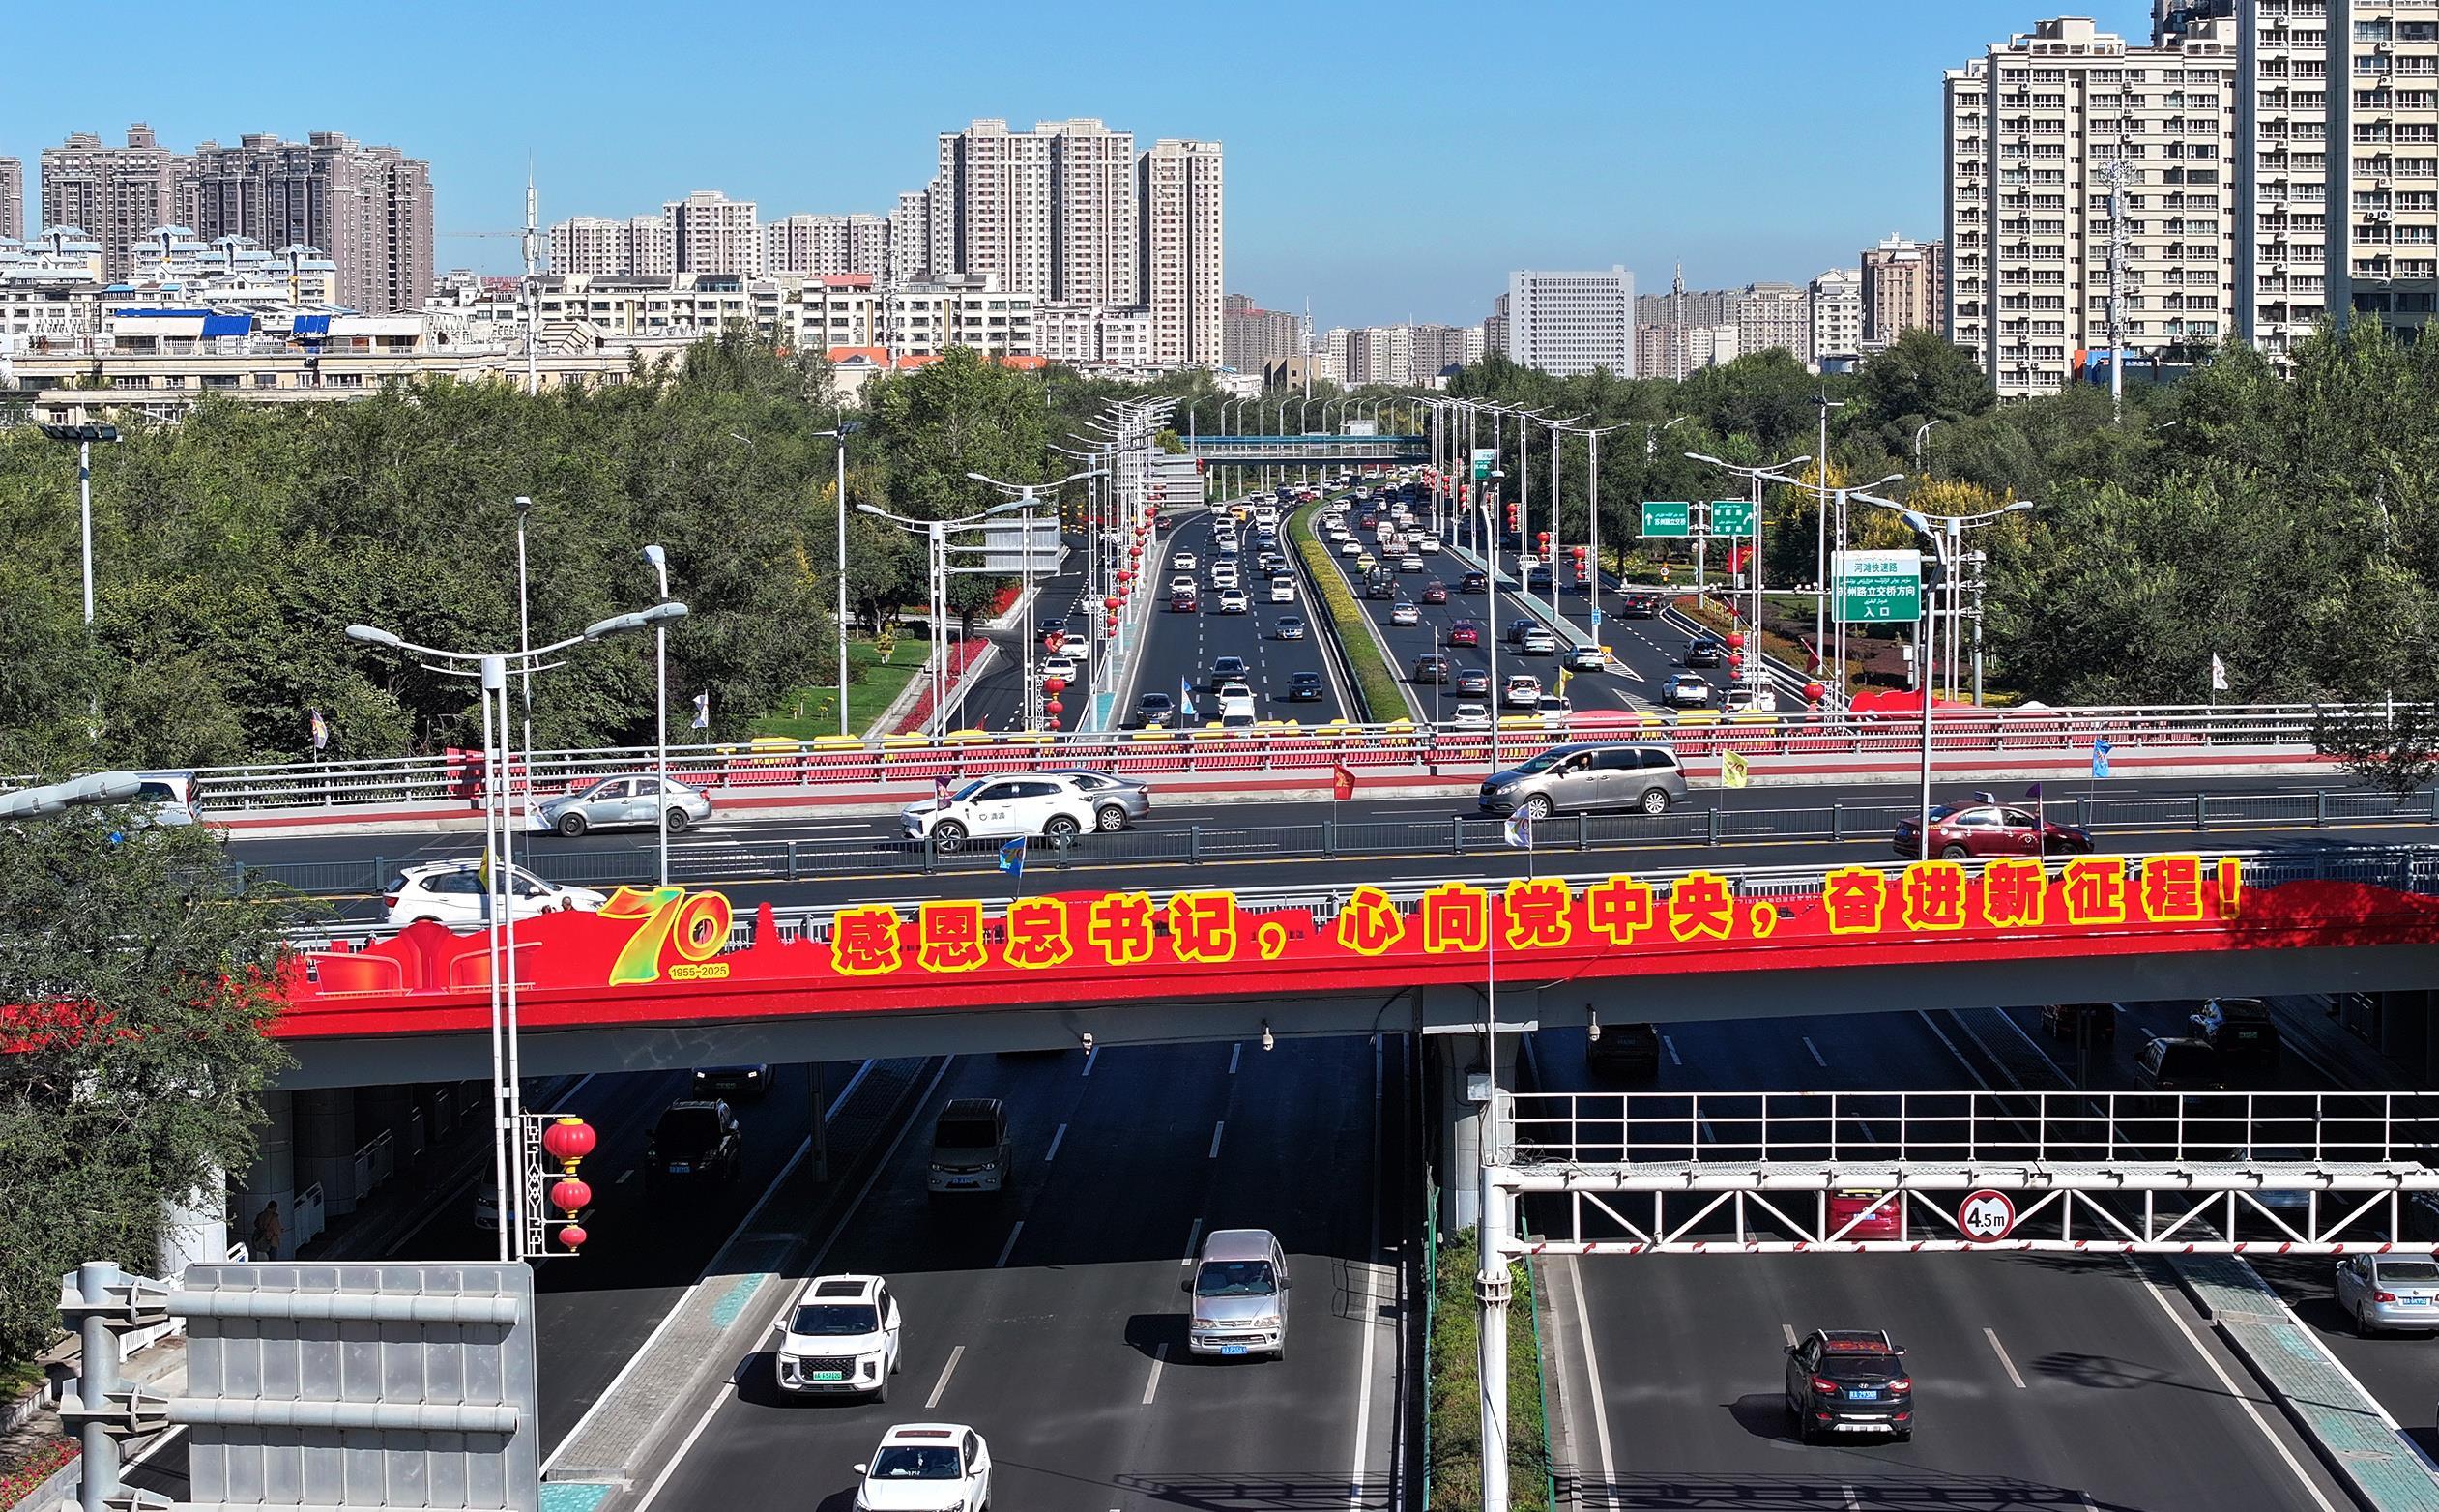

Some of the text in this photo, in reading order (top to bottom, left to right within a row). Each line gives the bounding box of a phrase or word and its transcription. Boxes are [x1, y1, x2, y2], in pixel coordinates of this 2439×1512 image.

[1854, 562, 1898, 573] 河滩快速路
[1864, 606, 1890, 618] 入口
[596, 886, 733, 987] 70
[671, 966, 727, 978] 1955-2025
[1967, 1207, 2005, 1228] 4.5m
